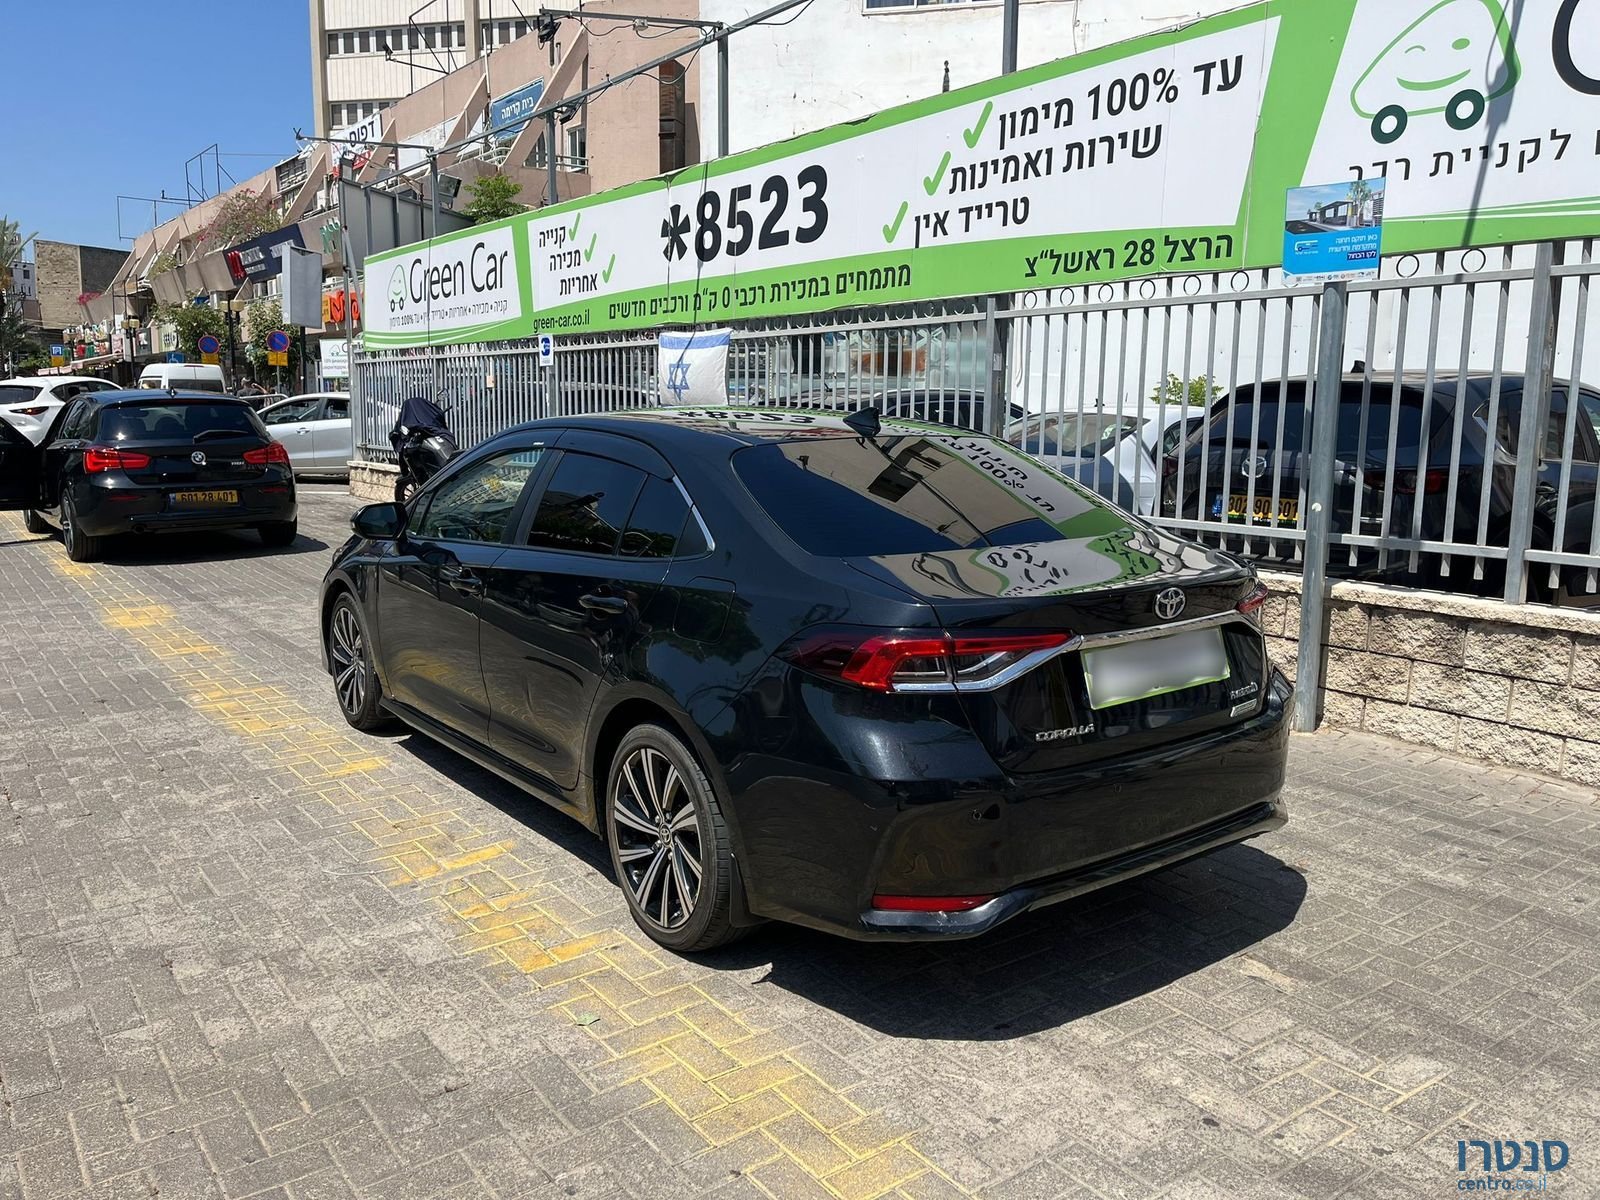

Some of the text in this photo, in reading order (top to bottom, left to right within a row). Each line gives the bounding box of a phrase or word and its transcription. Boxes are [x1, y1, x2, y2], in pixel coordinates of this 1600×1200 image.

[999, 54, 1244, 150] עד 100% מימון
[948, 124, 1162, 195] שירות ואמינות
[1429, 128, 1571, 177] לקניית
[913, 196, 1030, 249] טרייד אין
[539, 226, 566, 249] קנייה
[1164, 233, 1233, 265] הרצל
[549, 249, 581, 271] מכירה
[1123, 238, 1156, 268] 28
[409, 242, 508, 304] Green Car
[559, 273, 598, 296] אחריות
[835, 263, 911, 294] מתמחים
[721, 286, 731, 308] 0
[734, 283, 765, 307] רכבי
[770, 276, 830, 304] במכירת
[608, 300, 647, 320] חדשים
[650, 295, 689, 316] ורכבים
[533, 308, 590, 334] green-car.co.il
[1035, 723, 1095, 742] COROLLA
